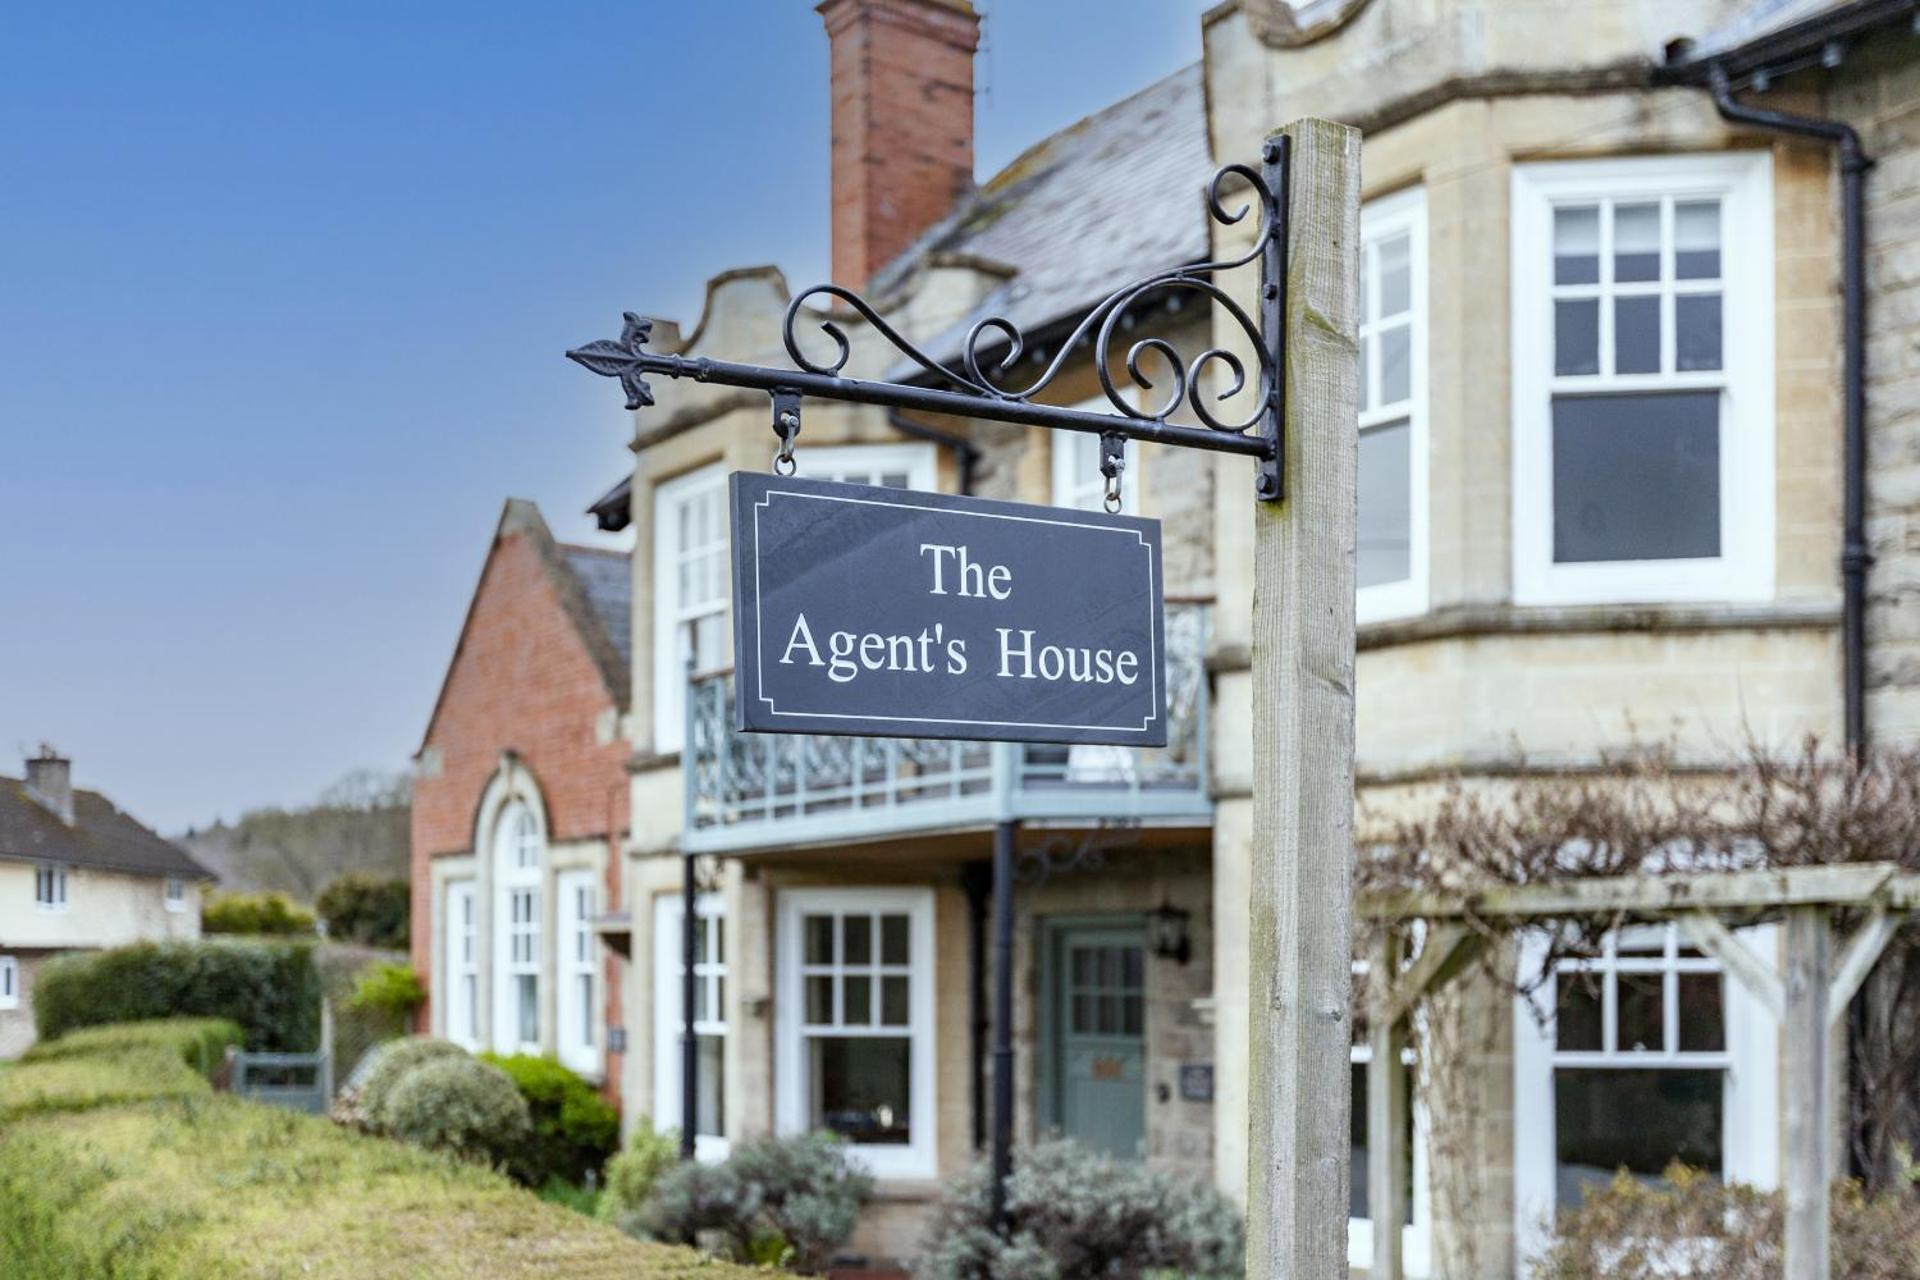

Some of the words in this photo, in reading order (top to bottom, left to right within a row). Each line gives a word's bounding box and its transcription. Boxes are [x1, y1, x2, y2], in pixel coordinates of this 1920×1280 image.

[919, 543, 1012, 601] The
[778, 612, 968, 683] Agent's
[995, 627, 1139, 686] House
